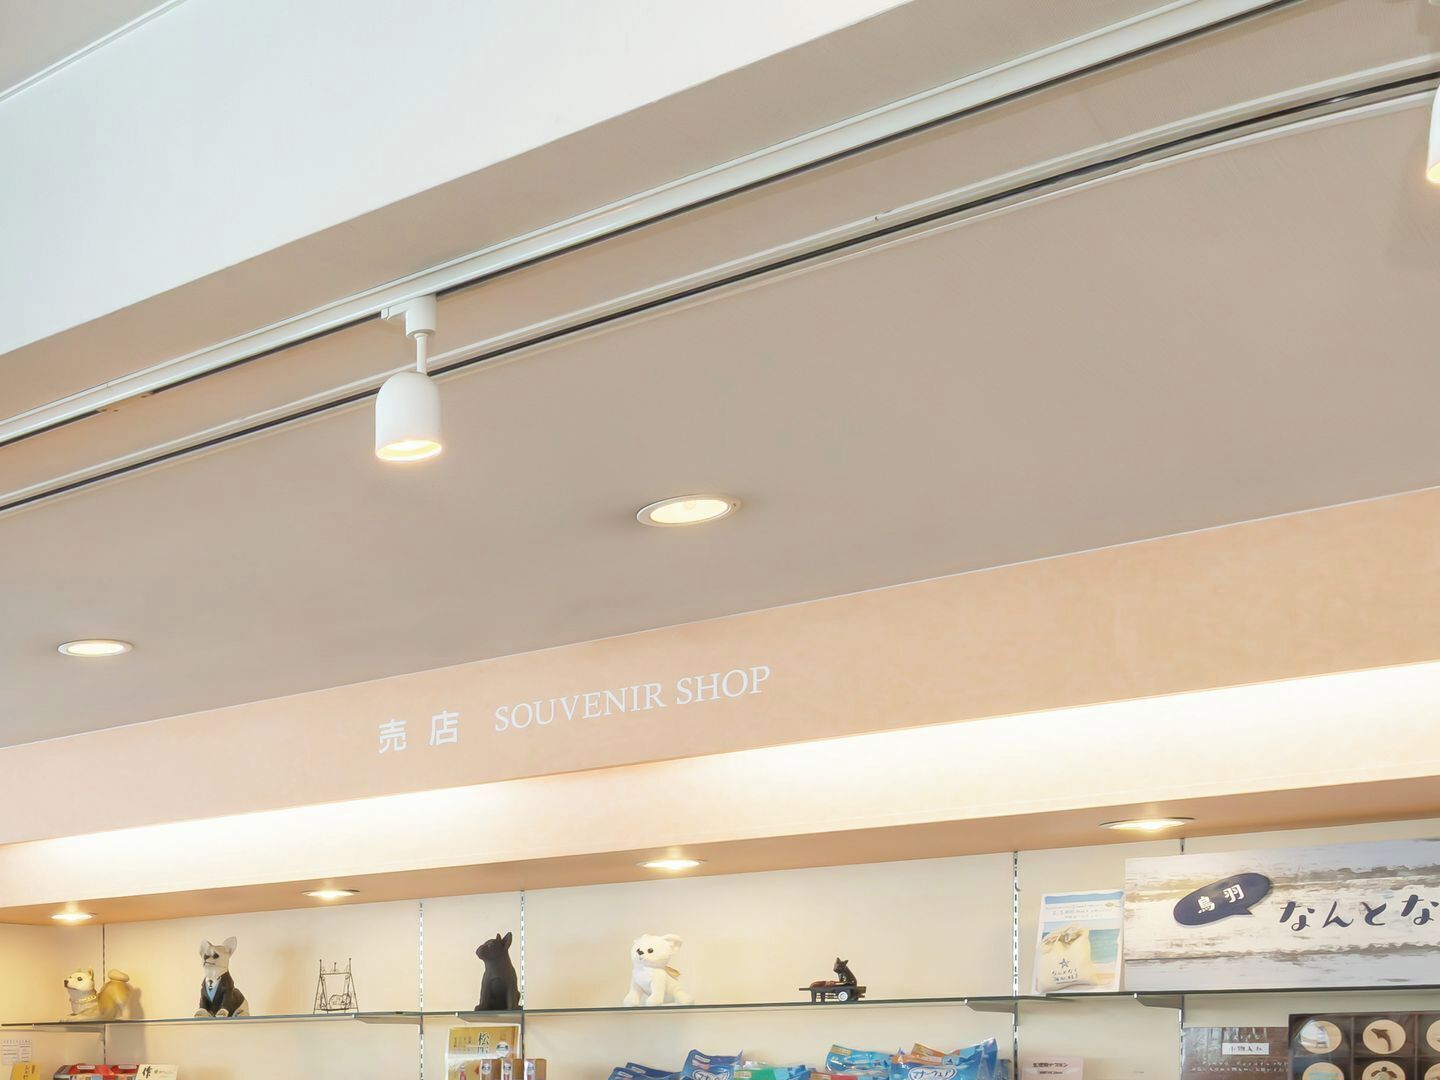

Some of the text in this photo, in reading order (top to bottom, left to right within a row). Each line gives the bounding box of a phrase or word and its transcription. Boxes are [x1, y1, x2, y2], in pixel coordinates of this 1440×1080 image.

[493, 664, 772, 733] SOUVENIR SHOP
[1197, 883, 1246, 914] 鳥羽
[1278, 893, 1440, 932] なんとな
[914, 1069, 954, 1080] マナーウェア
